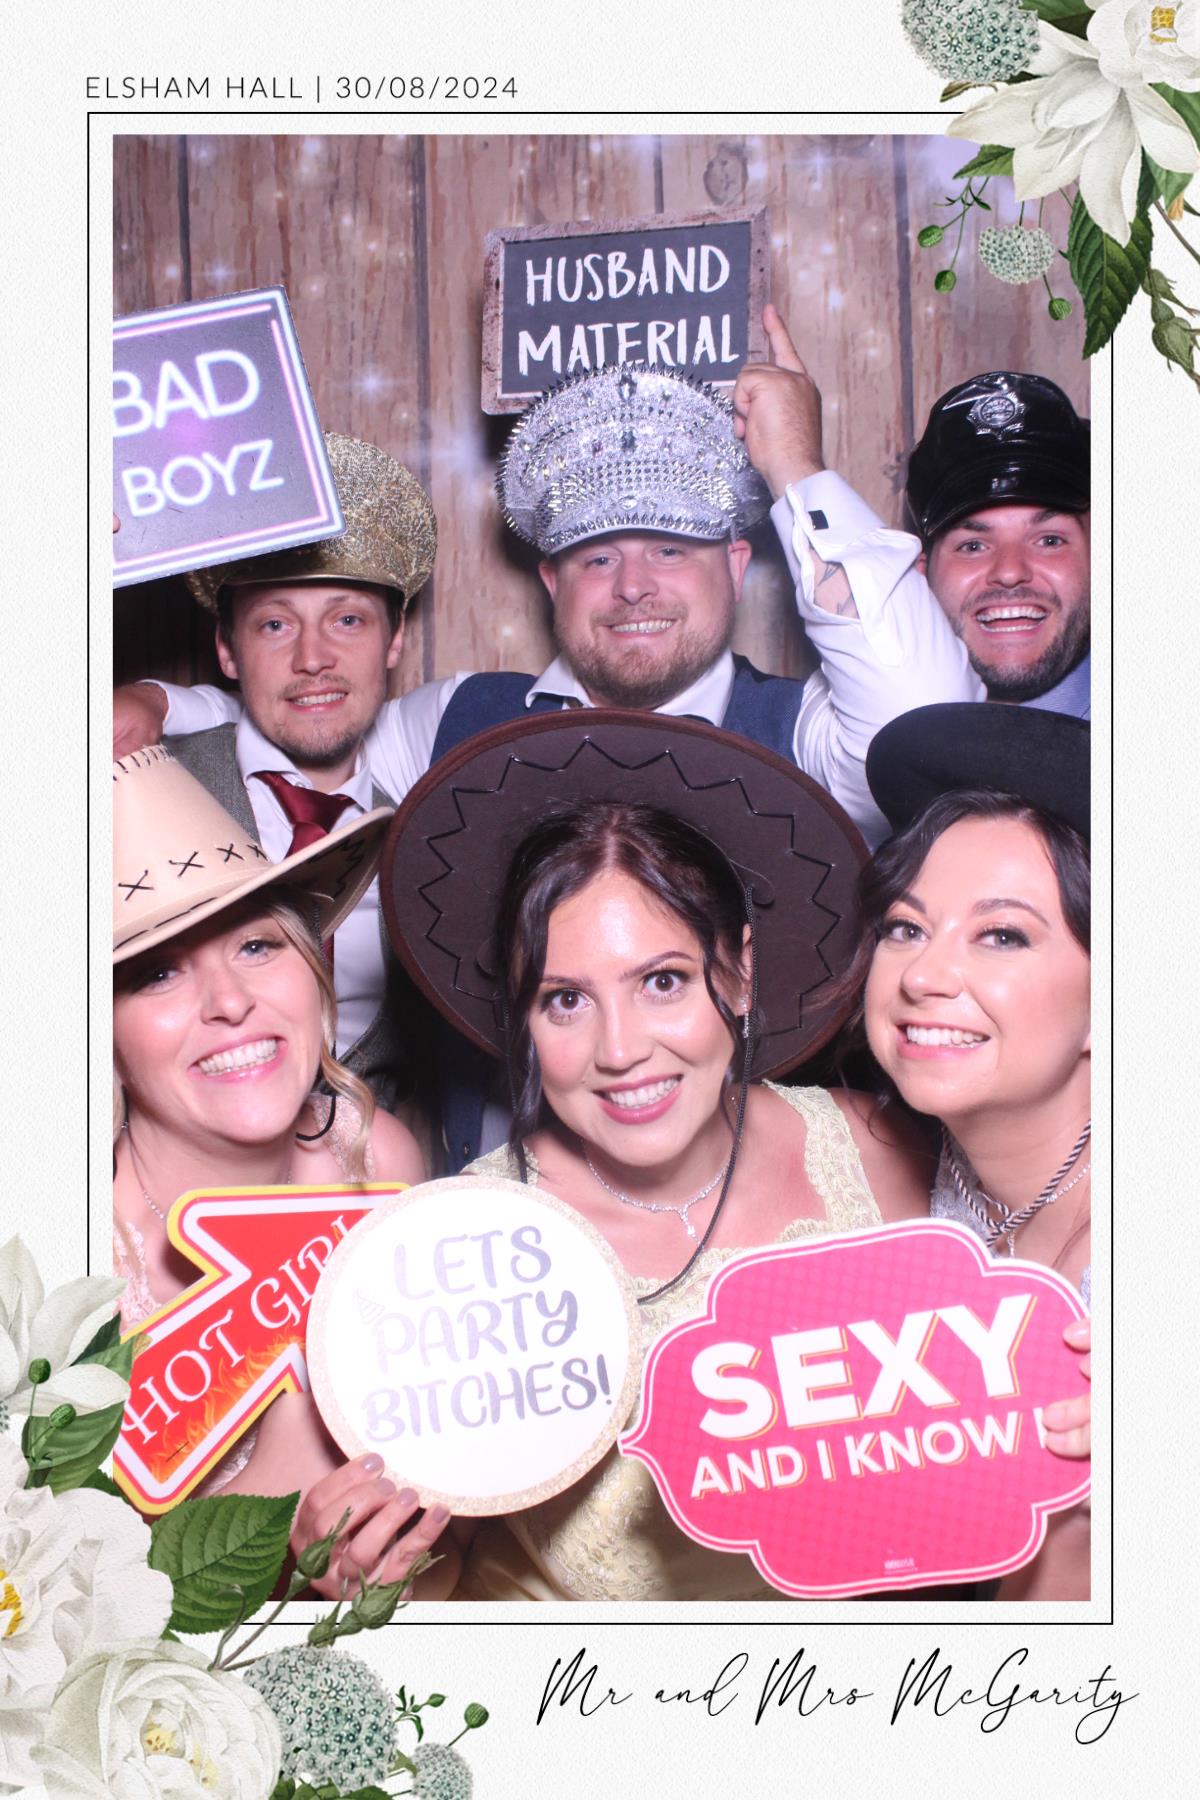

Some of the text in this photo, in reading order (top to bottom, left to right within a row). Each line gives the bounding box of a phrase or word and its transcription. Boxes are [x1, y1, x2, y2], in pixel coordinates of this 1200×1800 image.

[526, 245, 730, 306] HUSBAND
[518, 314, 740, 376] MATERIAL
[113, 349, 260, 437] BAD
[122, 439, 285, 517] BOYZ
[393, 1225, 552, 1301] LETS
[371, 1289, 579, 1374] PARTY
[691, 1293, 1038, 1440] SEXY
[121, 1308, 246, 1445] HOT
[361, 1353, 613, 1443] BITCHES!
[690, 1444, 808, 1500] AND
[816, 1438, 837, 1482] I
[844, 1410, 1024, 1478] KNOW
